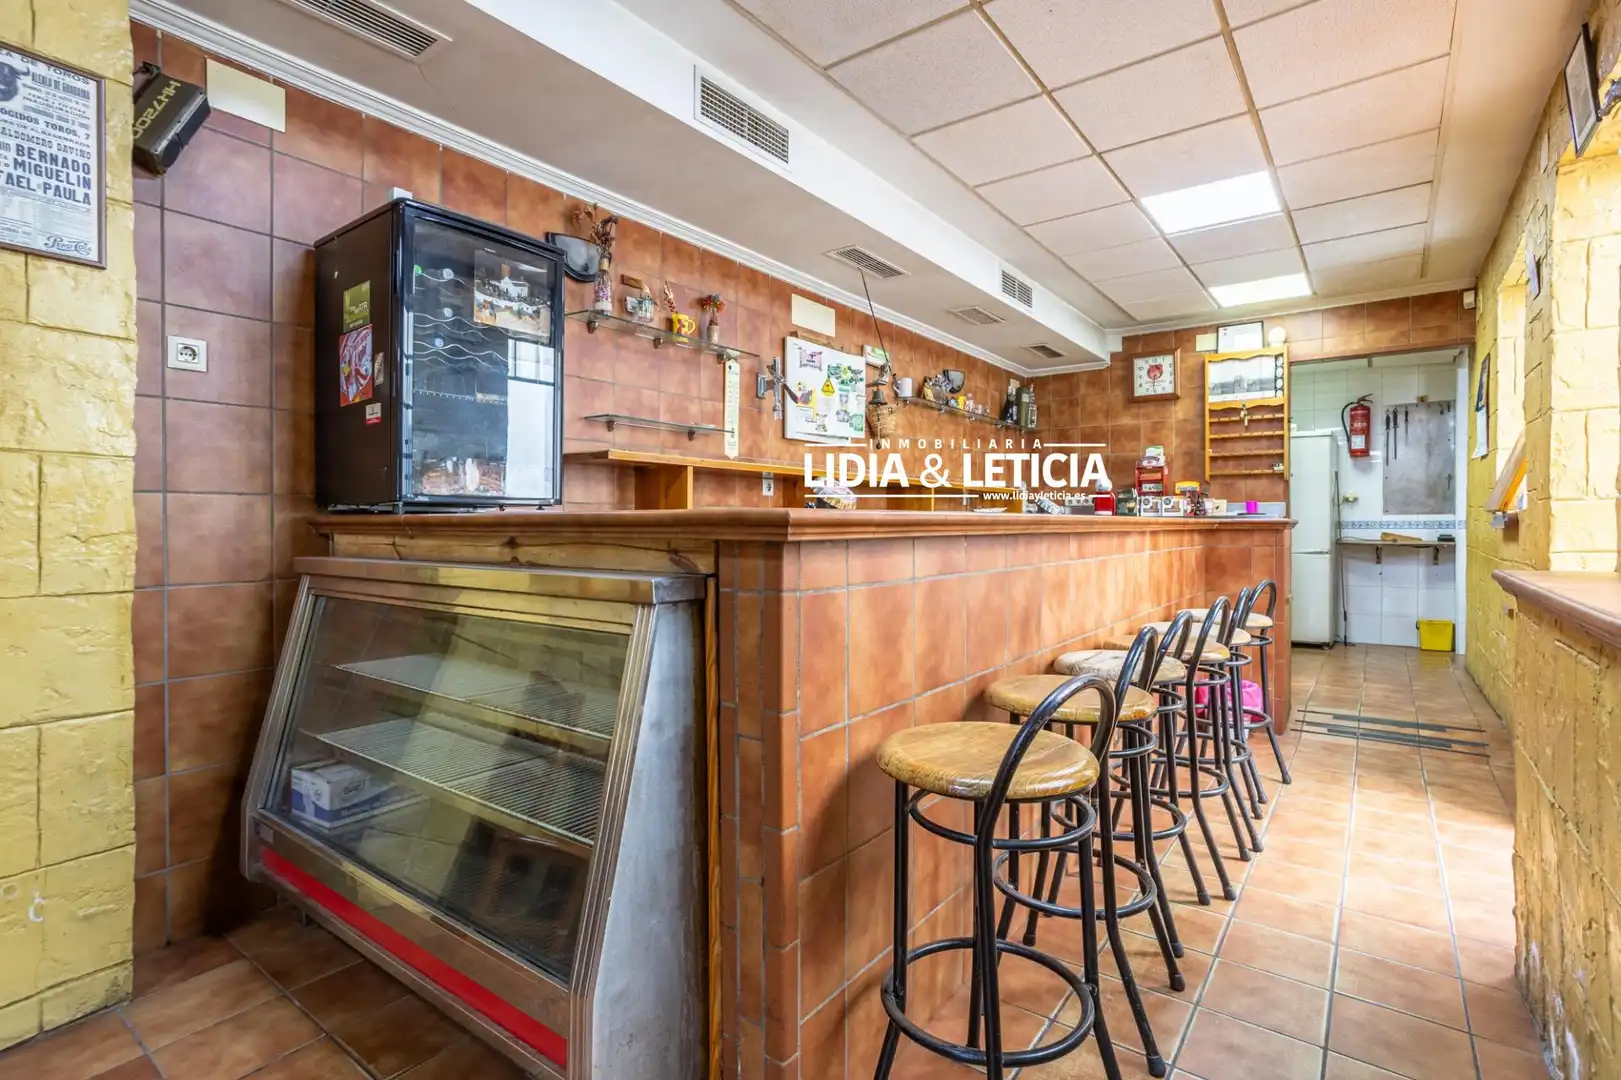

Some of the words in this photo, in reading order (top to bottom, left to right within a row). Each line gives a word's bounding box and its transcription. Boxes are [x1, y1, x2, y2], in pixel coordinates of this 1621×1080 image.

[0, 107, 40, 125] OGIDOS
[83, 132, 91, 141] 7
[13, 156, 92, 190] MIGUELIN
[15, 143, 91, 176] BERNADO
[42, 181, 91, 206] PAULA
